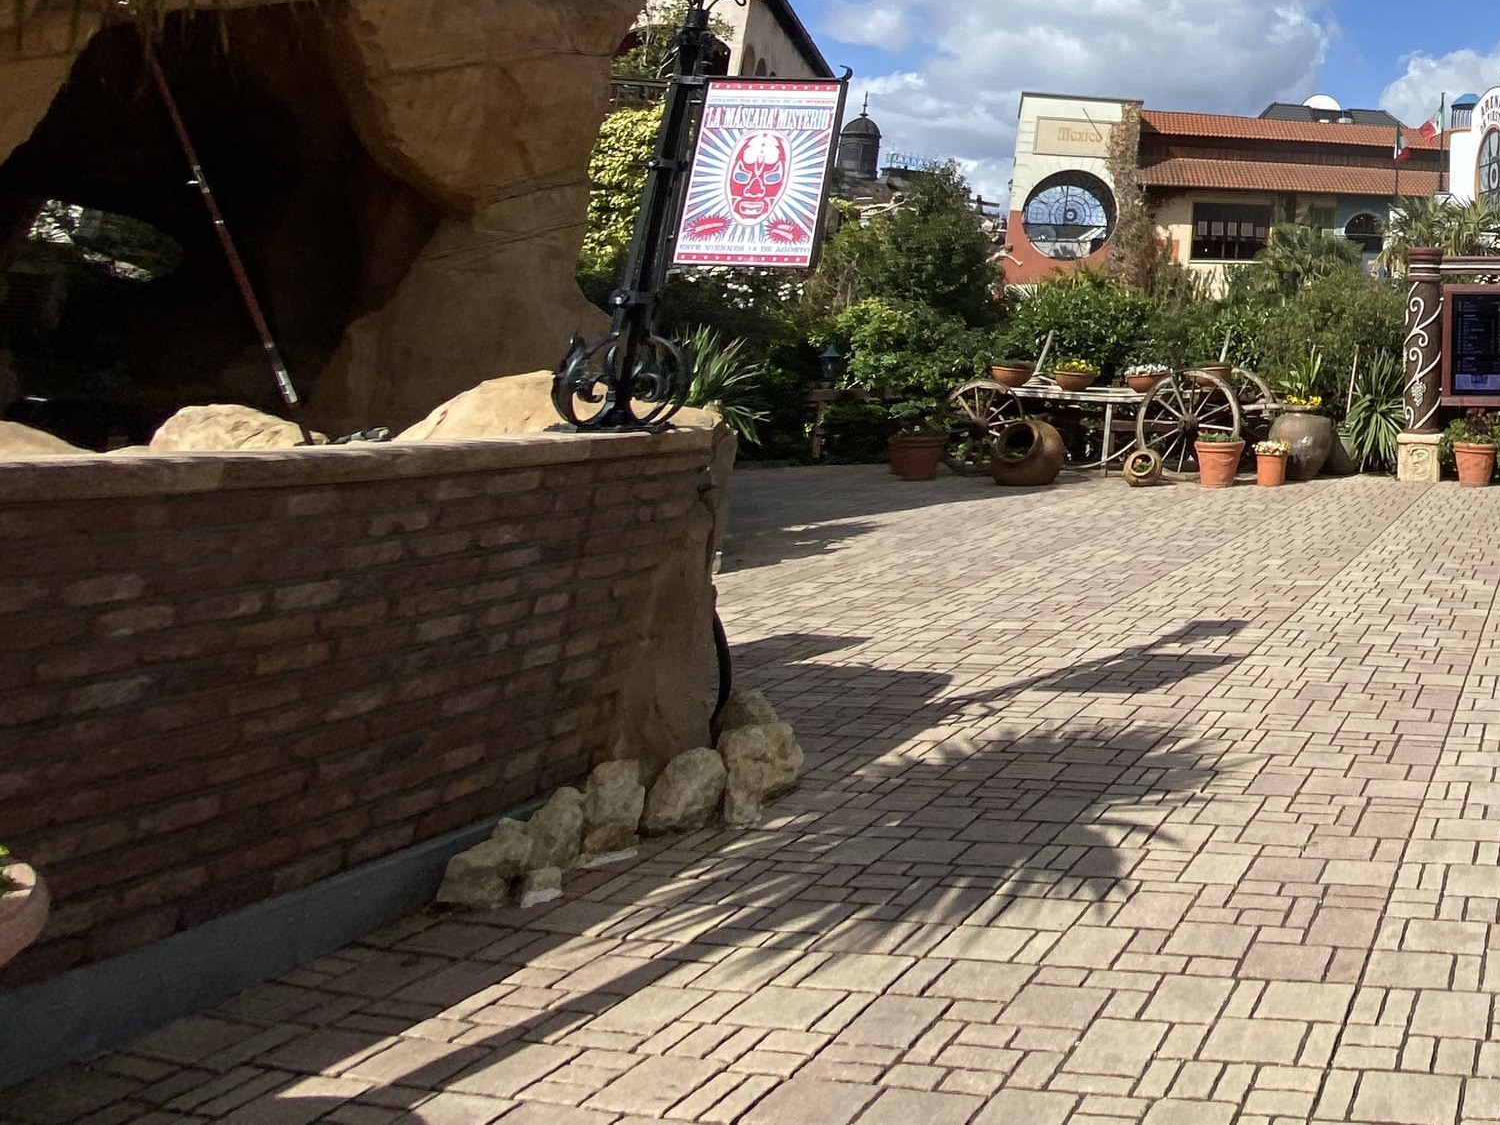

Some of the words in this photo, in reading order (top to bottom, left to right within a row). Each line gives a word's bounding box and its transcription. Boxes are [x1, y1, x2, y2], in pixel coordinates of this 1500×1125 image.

[722, 105, 776, 129] MÁSCARA
[775, 108, 830, 130] MISTERIO
[1058, 127, 1102, 142] Mexico
